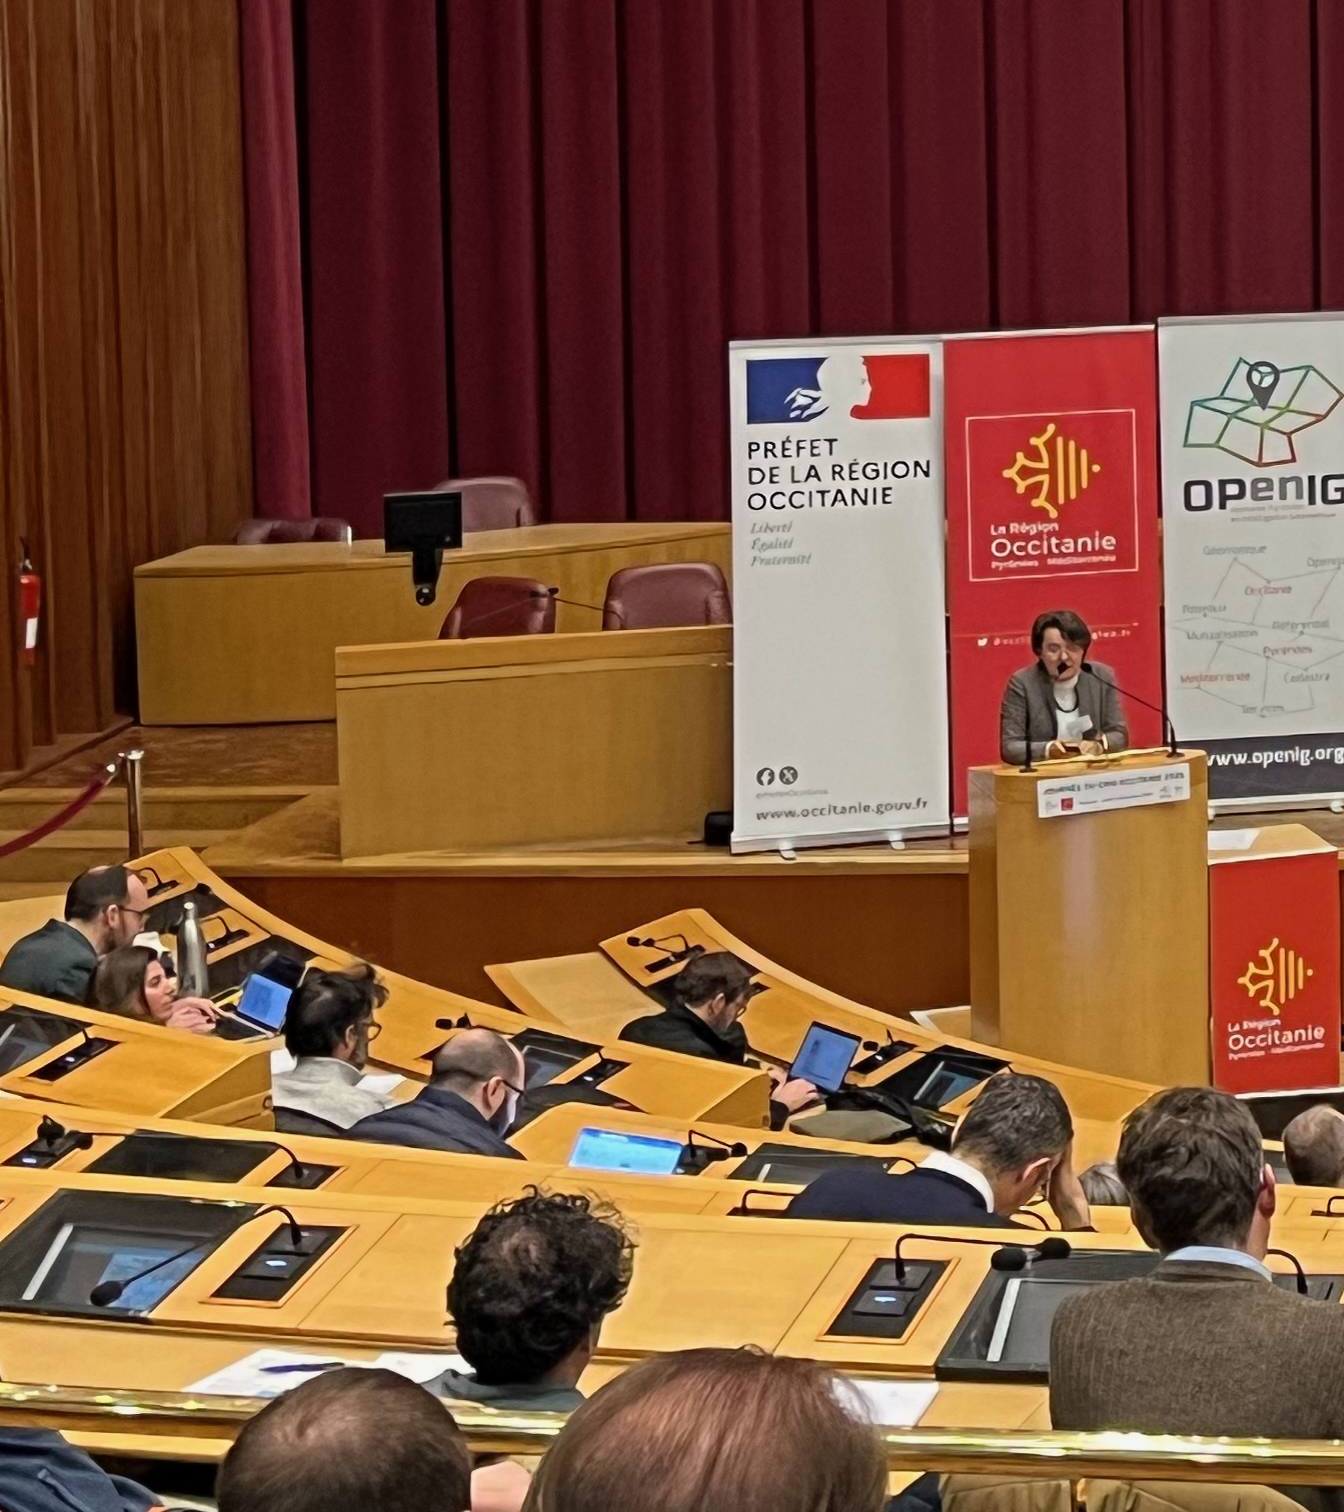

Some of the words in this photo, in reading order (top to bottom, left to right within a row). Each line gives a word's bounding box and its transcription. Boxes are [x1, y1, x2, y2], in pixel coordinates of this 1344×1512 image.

[747, 435, 839, 460] PRÉFET
[747, 466, 781, 486] DE
[790, 464, 822, 484] LA
[831, 458, 931, 482] RÉGION
[747, 486, 893, 511] OCCITANIE
[990, 530, 1117, 558] Occitanie
[1228, 1024, 1326, 1051] Occitanie
